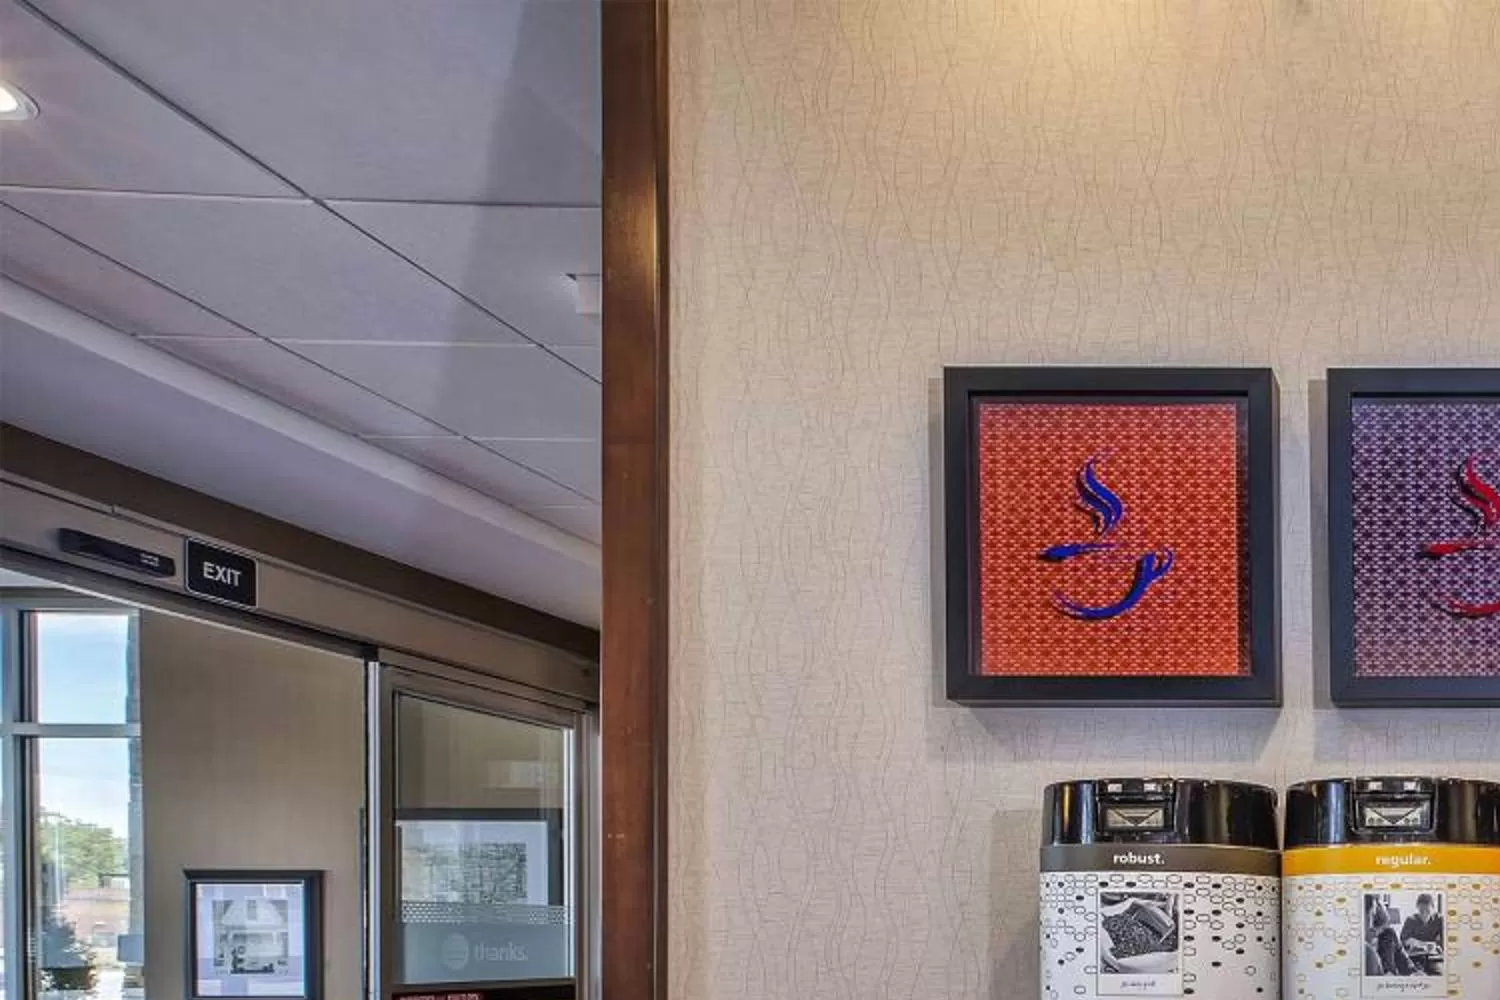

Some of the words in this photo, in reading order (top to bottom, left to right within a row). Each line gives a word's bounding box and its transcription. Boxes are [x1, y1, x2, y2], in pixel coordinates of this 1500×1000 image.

[202, 561, 242, 587] EXIT
[1112, 851, 1165, 865] robust.
[1375, 853, 1431, 868] regular.
